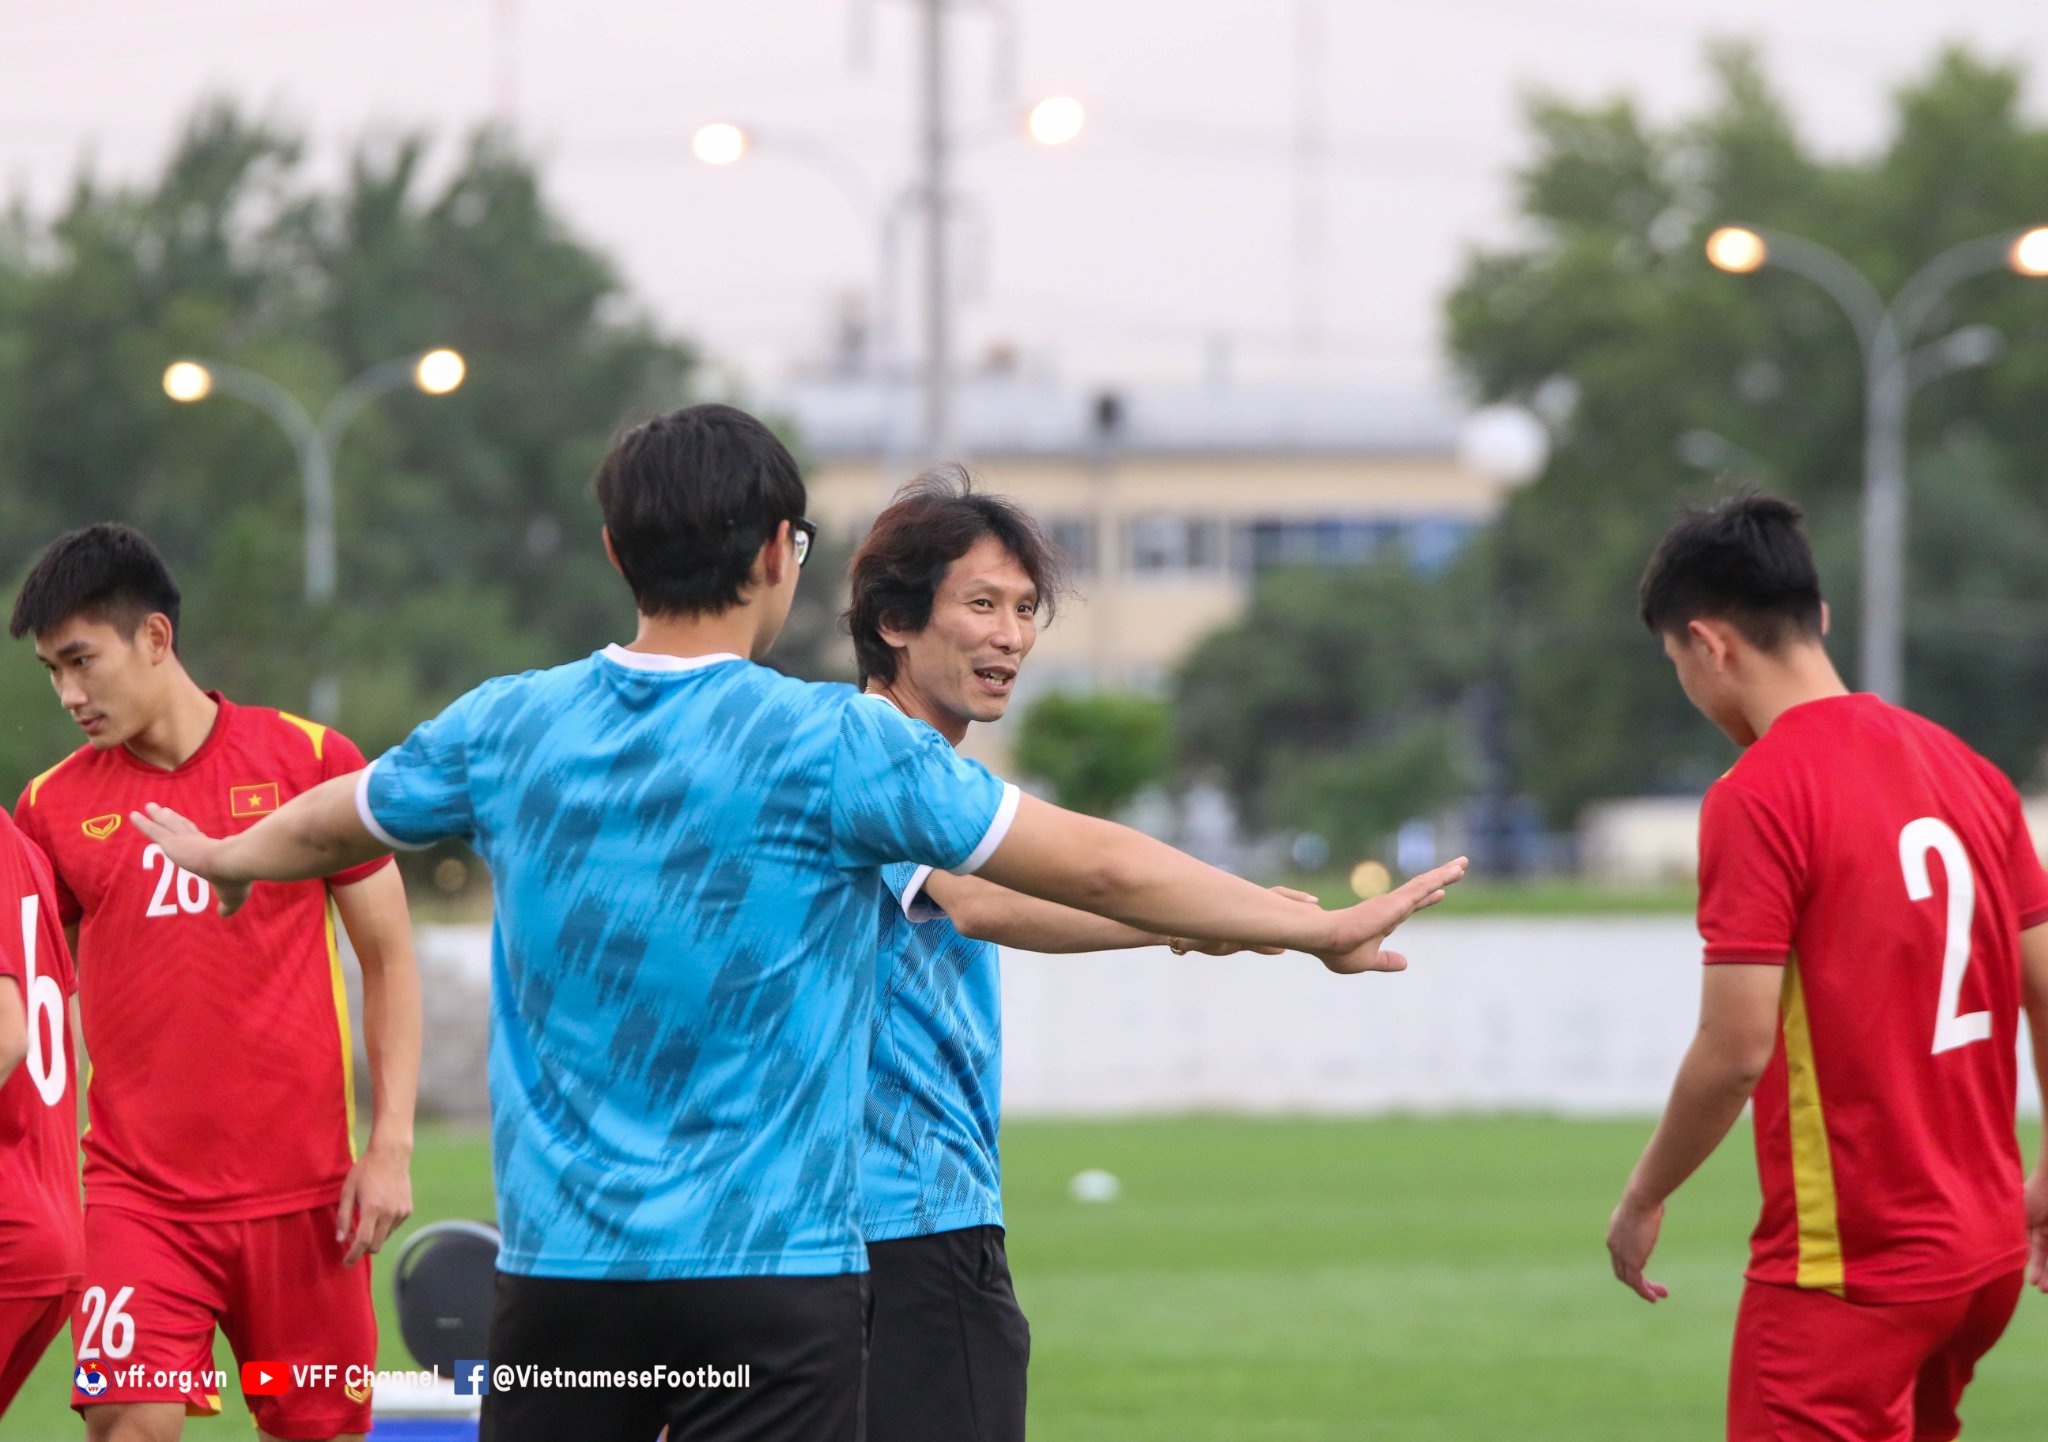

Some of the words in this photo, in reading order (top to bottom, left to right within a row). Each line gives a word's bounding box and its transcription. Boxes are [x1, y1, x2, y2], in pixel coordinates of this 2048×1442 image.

[142, 843, 210, 916] 26
[1898, 816, 1993, 1056] 2
[77, 1285, 136, 1360] 26
